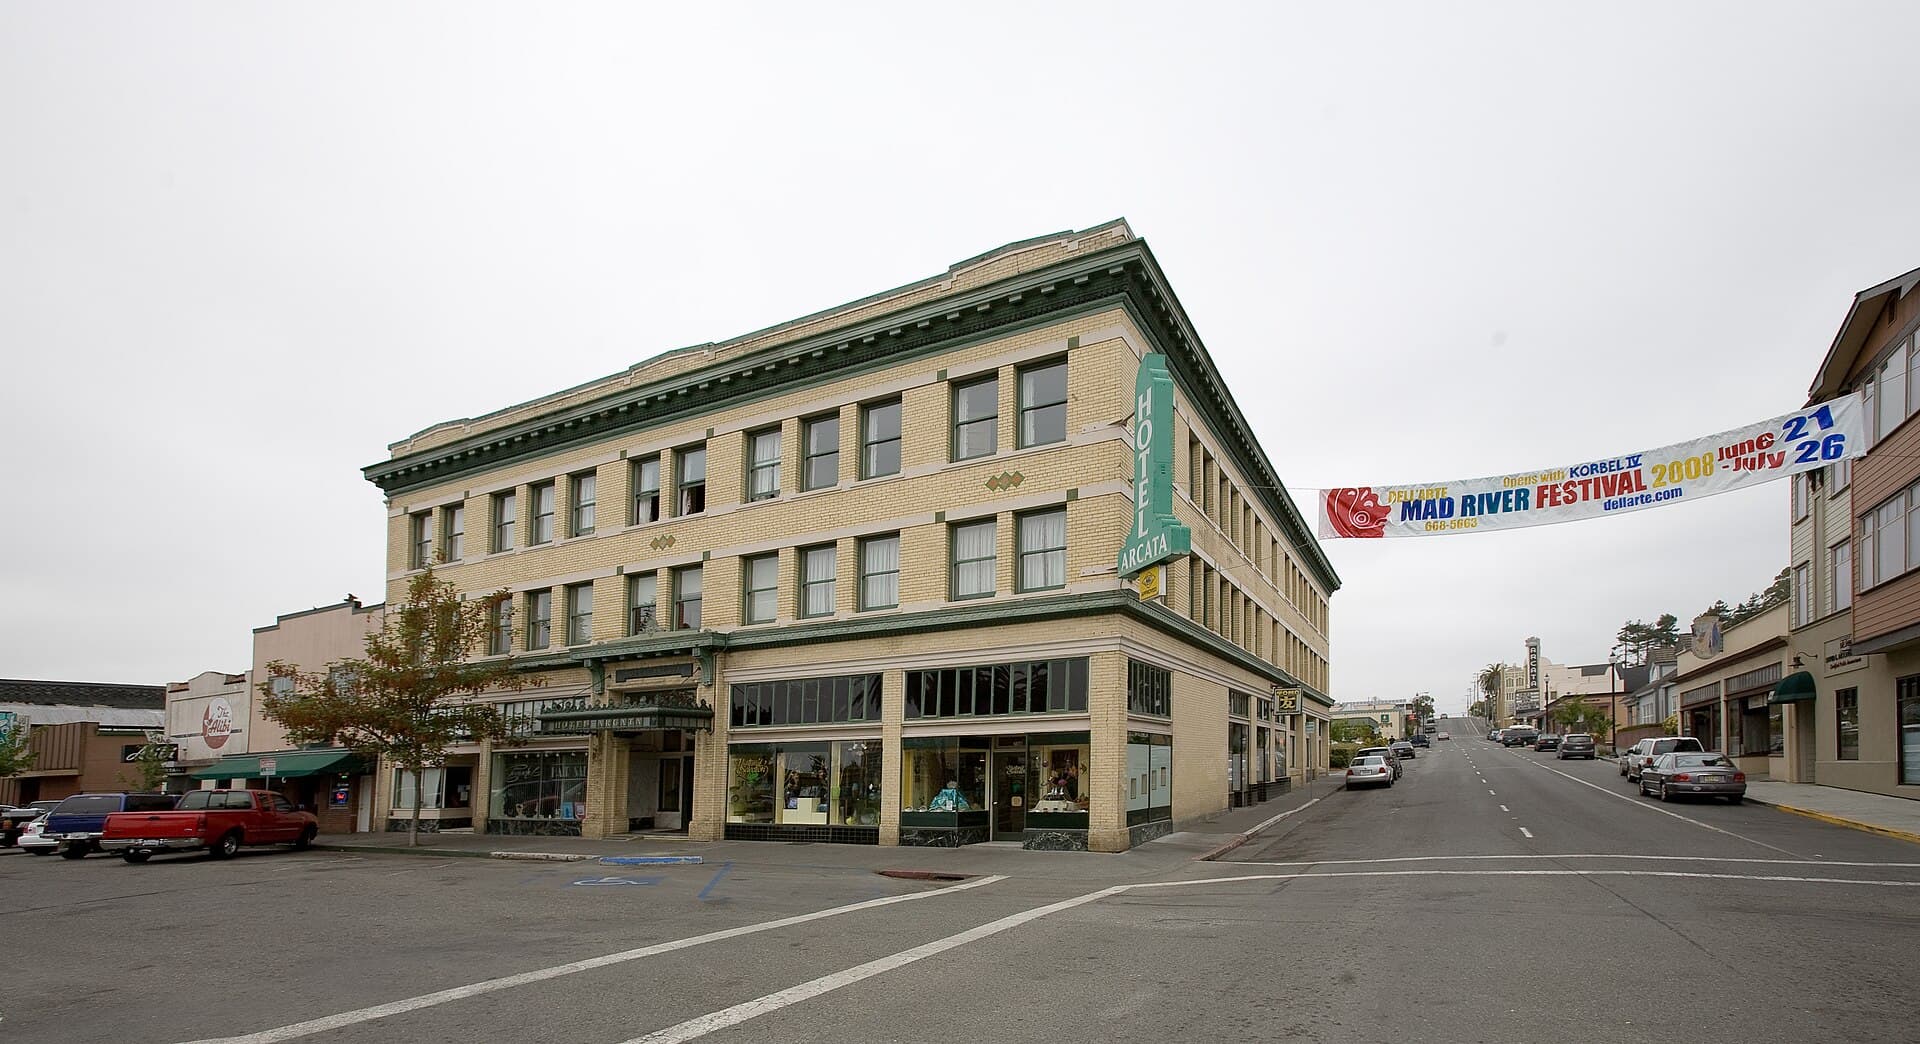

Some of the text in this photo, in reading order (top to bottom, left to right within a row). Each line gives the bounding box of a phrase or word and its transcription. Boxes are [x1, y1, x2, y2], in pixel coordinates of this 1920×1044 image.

[1782, 405, 1834, 443] 21
[1137, 386, 1153, 540] HOTEL
[1794, 433, 1846, 464] 26
[1400, 452, 1715, 522] MAD RIVER FESTIVAL 2008
[1503, 454, 1643, 488] Opens with KORBEL IV
[1387, 486, 1448, 505] DELL'ARTE
[1603, 486, 1683, 511] dellarte.com
[1121, 532, 1168, 572] ARCATA
